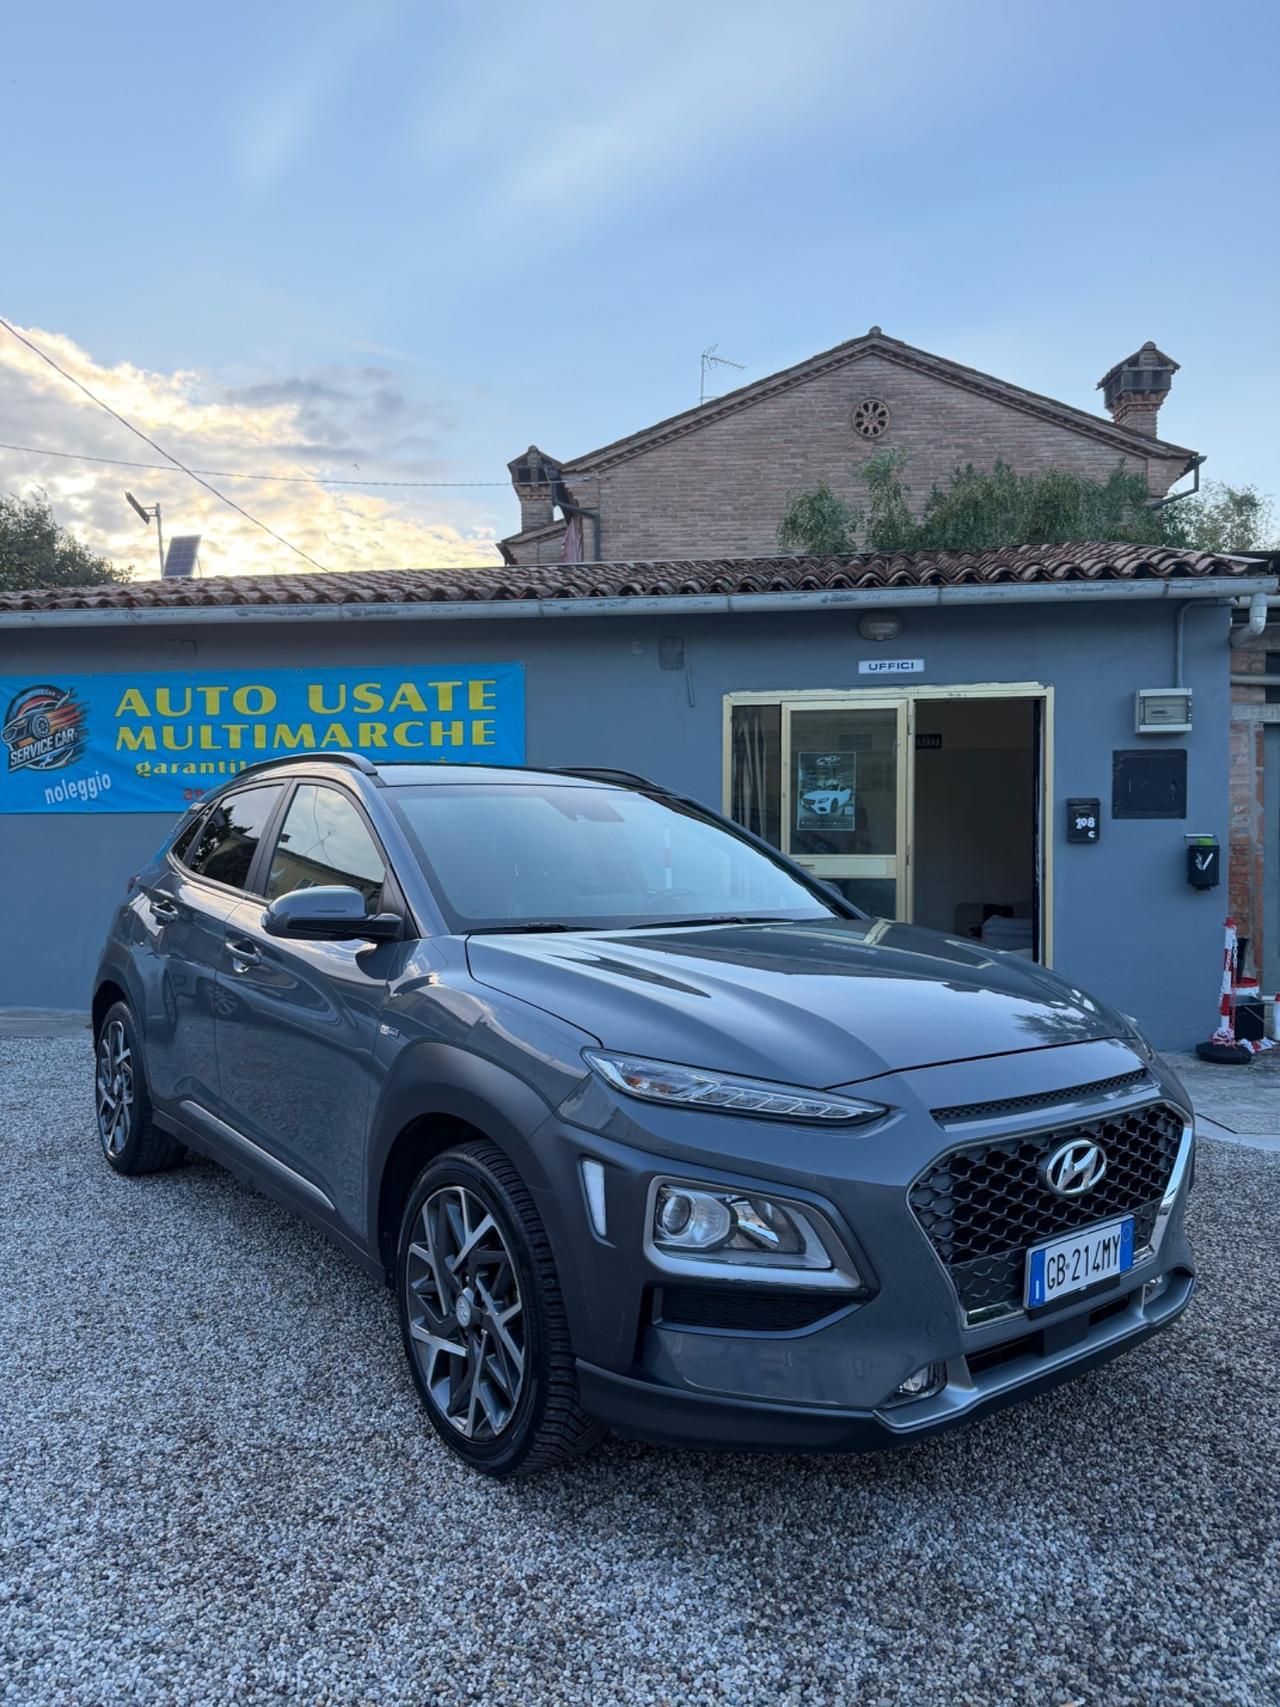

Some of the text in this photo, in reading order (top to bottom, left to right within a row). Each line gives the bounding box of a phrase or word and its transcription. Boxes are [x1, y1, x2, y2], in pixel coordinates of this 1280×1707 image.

[869, 661, 914, 671] UFFICI
[115, 680, 497, 717] AUTO USATE
[10, 728, 75, 766] SERVICE CAR
[115, 719, 496, 751] MULTIMARCHE
[135, 759, 247, 778] garantit
[45, 770, 111, 804] noleggio
[1047, 1234, 1120, 1289] GB 214MY
